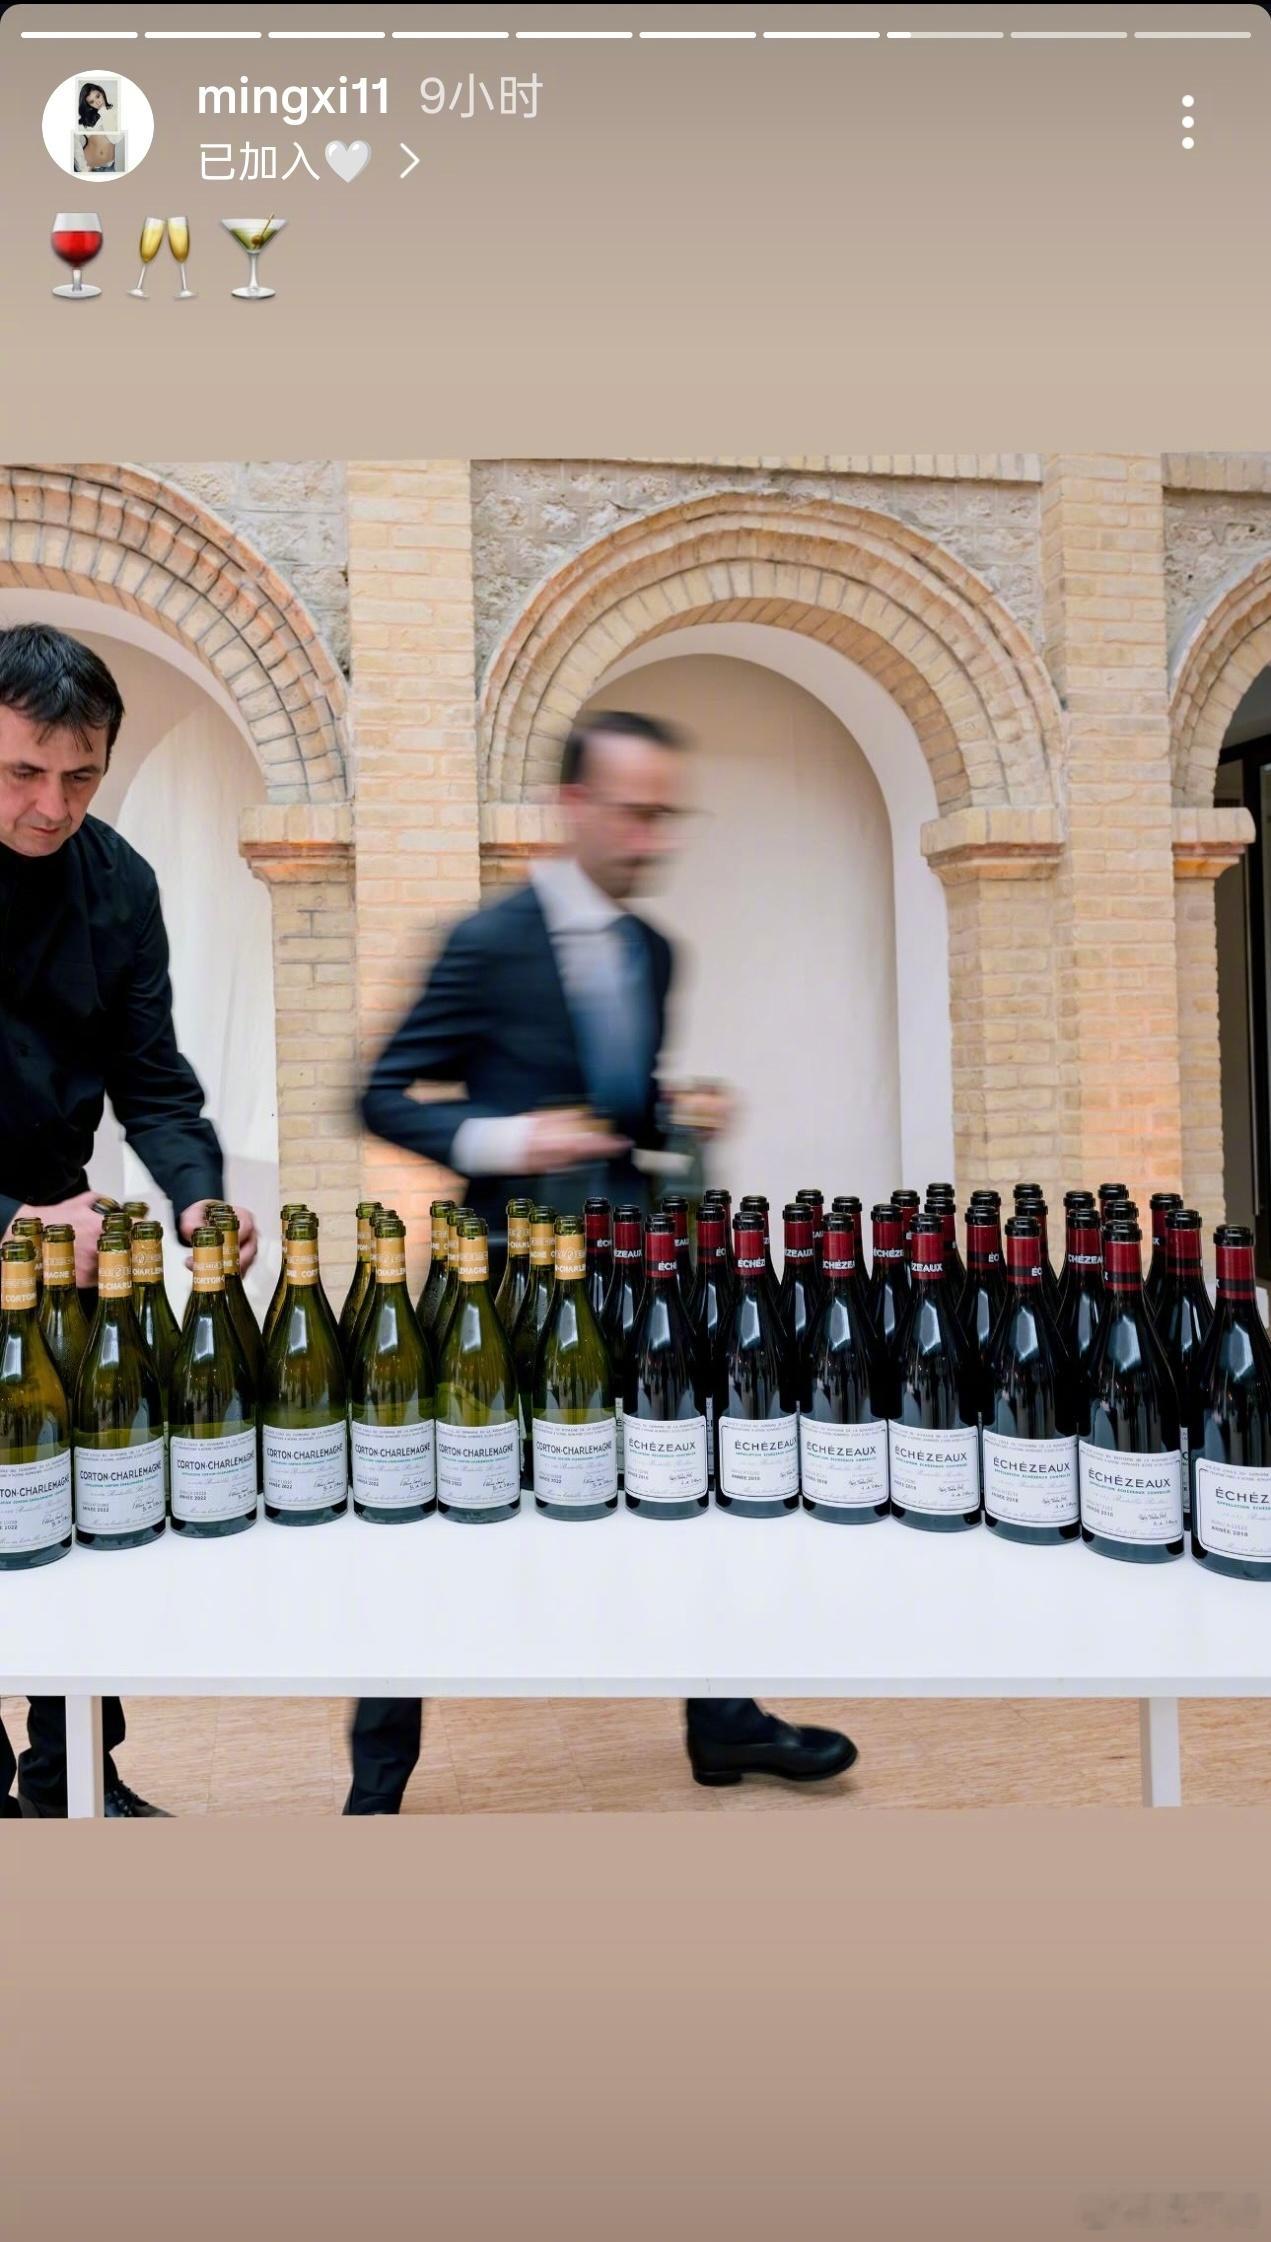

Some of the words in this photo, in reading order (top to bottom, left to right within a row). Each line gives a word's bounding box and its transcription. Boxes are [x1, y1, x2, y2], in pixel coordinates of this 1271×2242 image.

[265, 1442, 344, 1460] CORTON-CHARLEMAGNE
[535, 1440, 613, 1456] CORTON-CHARLEMAGNE
[628, 1437, 697, 1453] ÉCHÉZEAUX
[805, 1440, 877, 1457] ÉCHÉZEAUX
[894, 1445, 968, 1463] ÉCHÉZEAUX
[80, 1460, 163, 1482] CORTON-CHARLEMAGNE
[993, 1455, 1071, 1474] ÉCHÉZEAUX
[1088, 1467, 1171, 1489] ÉCHÉZEAUX
